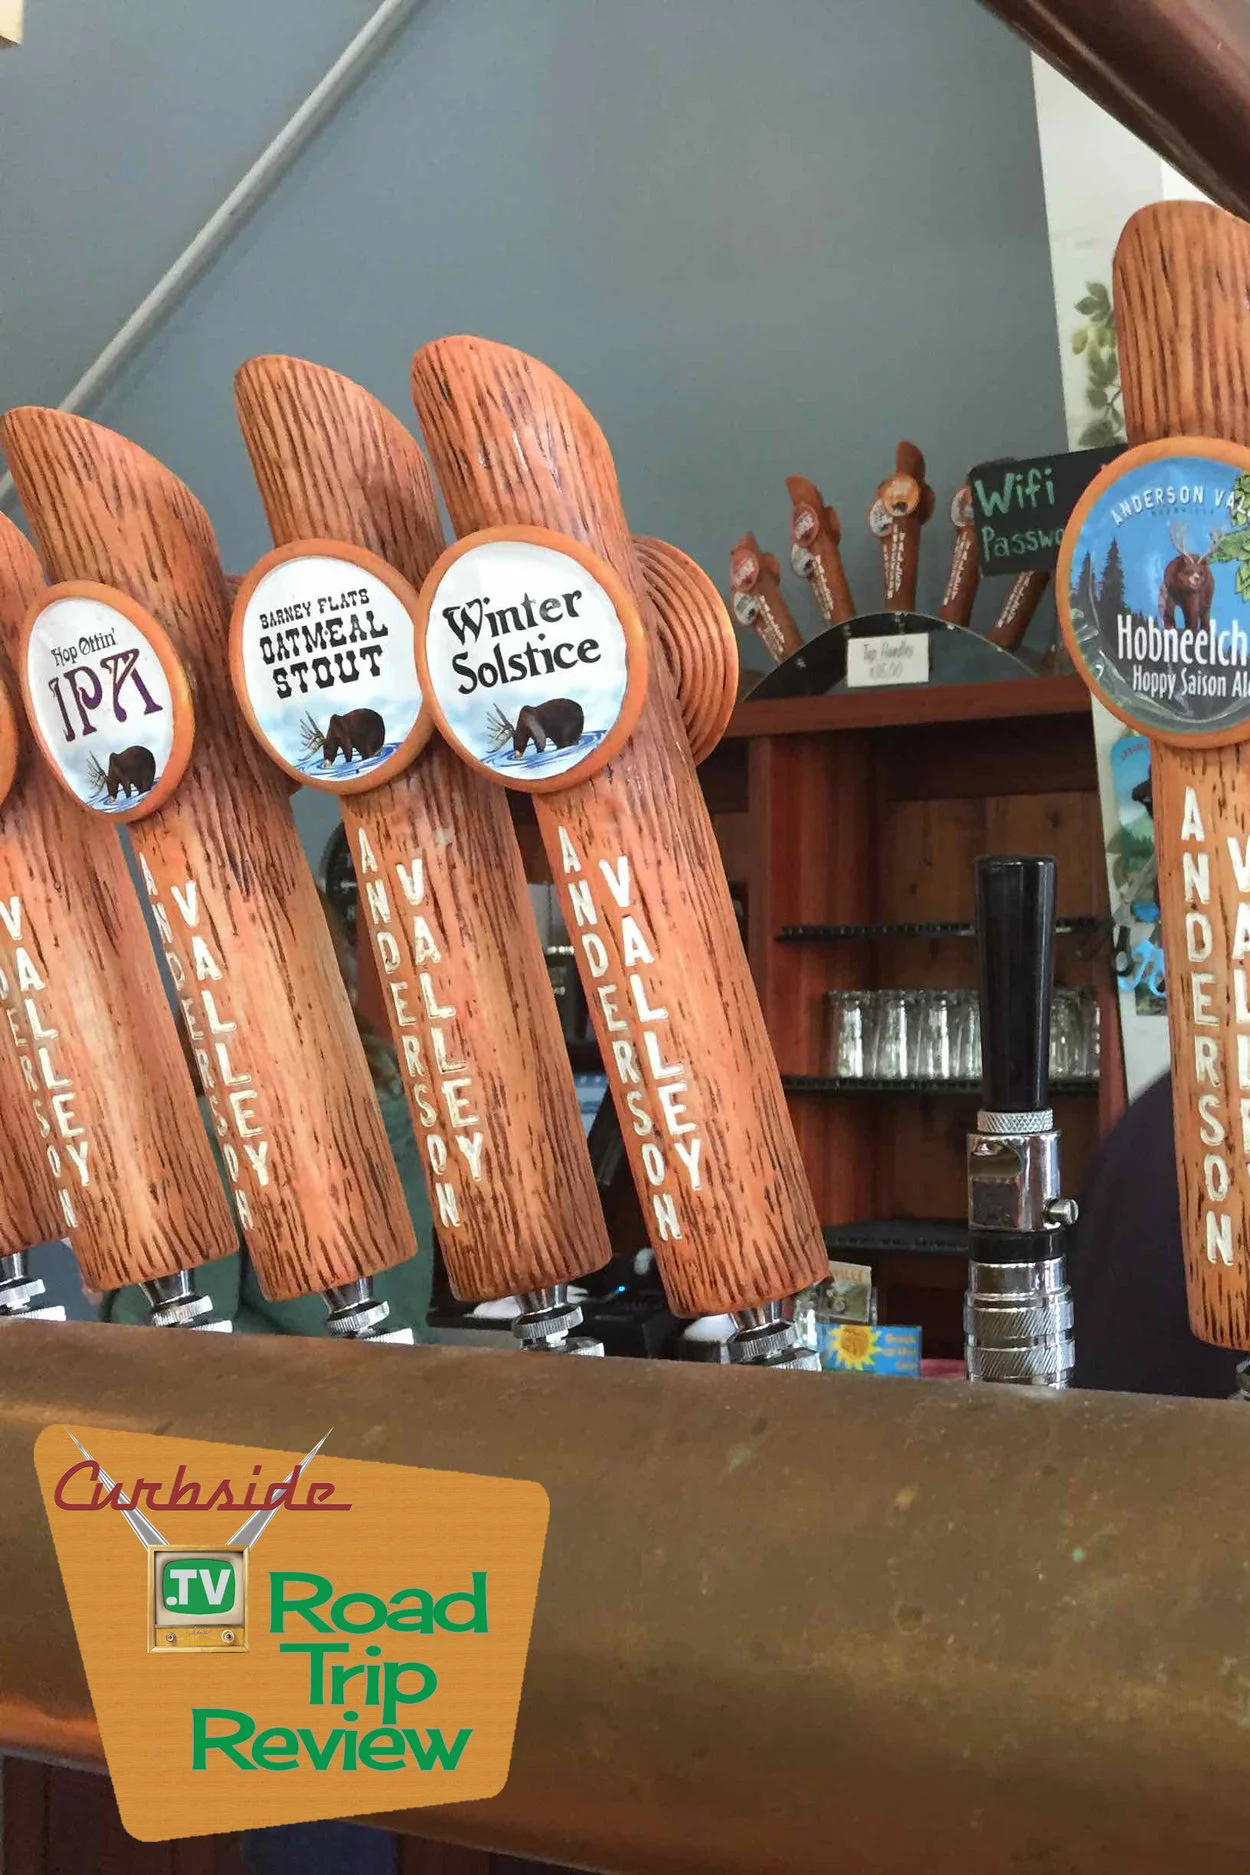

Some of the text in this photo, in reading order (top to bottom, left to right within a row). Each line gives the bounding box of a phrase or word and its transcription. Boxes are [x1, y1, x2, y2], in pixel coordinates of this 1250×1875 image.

[974, 468, 1055, 517] Wifi
[1111, 485, 1205, 527] ANDERSON
[259, 588, 370, 629] BARNEY FLATS
[259, 611, 388, 665] OATMEAL
[442, 590, 582, 646] Winter
[48, 648, 164, 743] IPA
[51, 645, 78, 668] Hop
[272, 645, 383, 700] STOUT
[451, 633, 602, 695] Solstice
[1132, 665, 1177, 700] Hoppy
[1180, 667, 1227, 698] Saison
[0, 896, 91, 1187] VALLEY
[138, 851, 256, 1230] ANDERSON
[170, 880, 271, 1187] VALLEY
[358, 827, 461, 1228] ANDERSON
[395, 857, 483, 1182] VALLEY
[558, 825, 683, 1242] ANDERSON
[599, 855, 703, 1191] VALLEY
[1180, 785, 1236, 1266] ANDERSON
